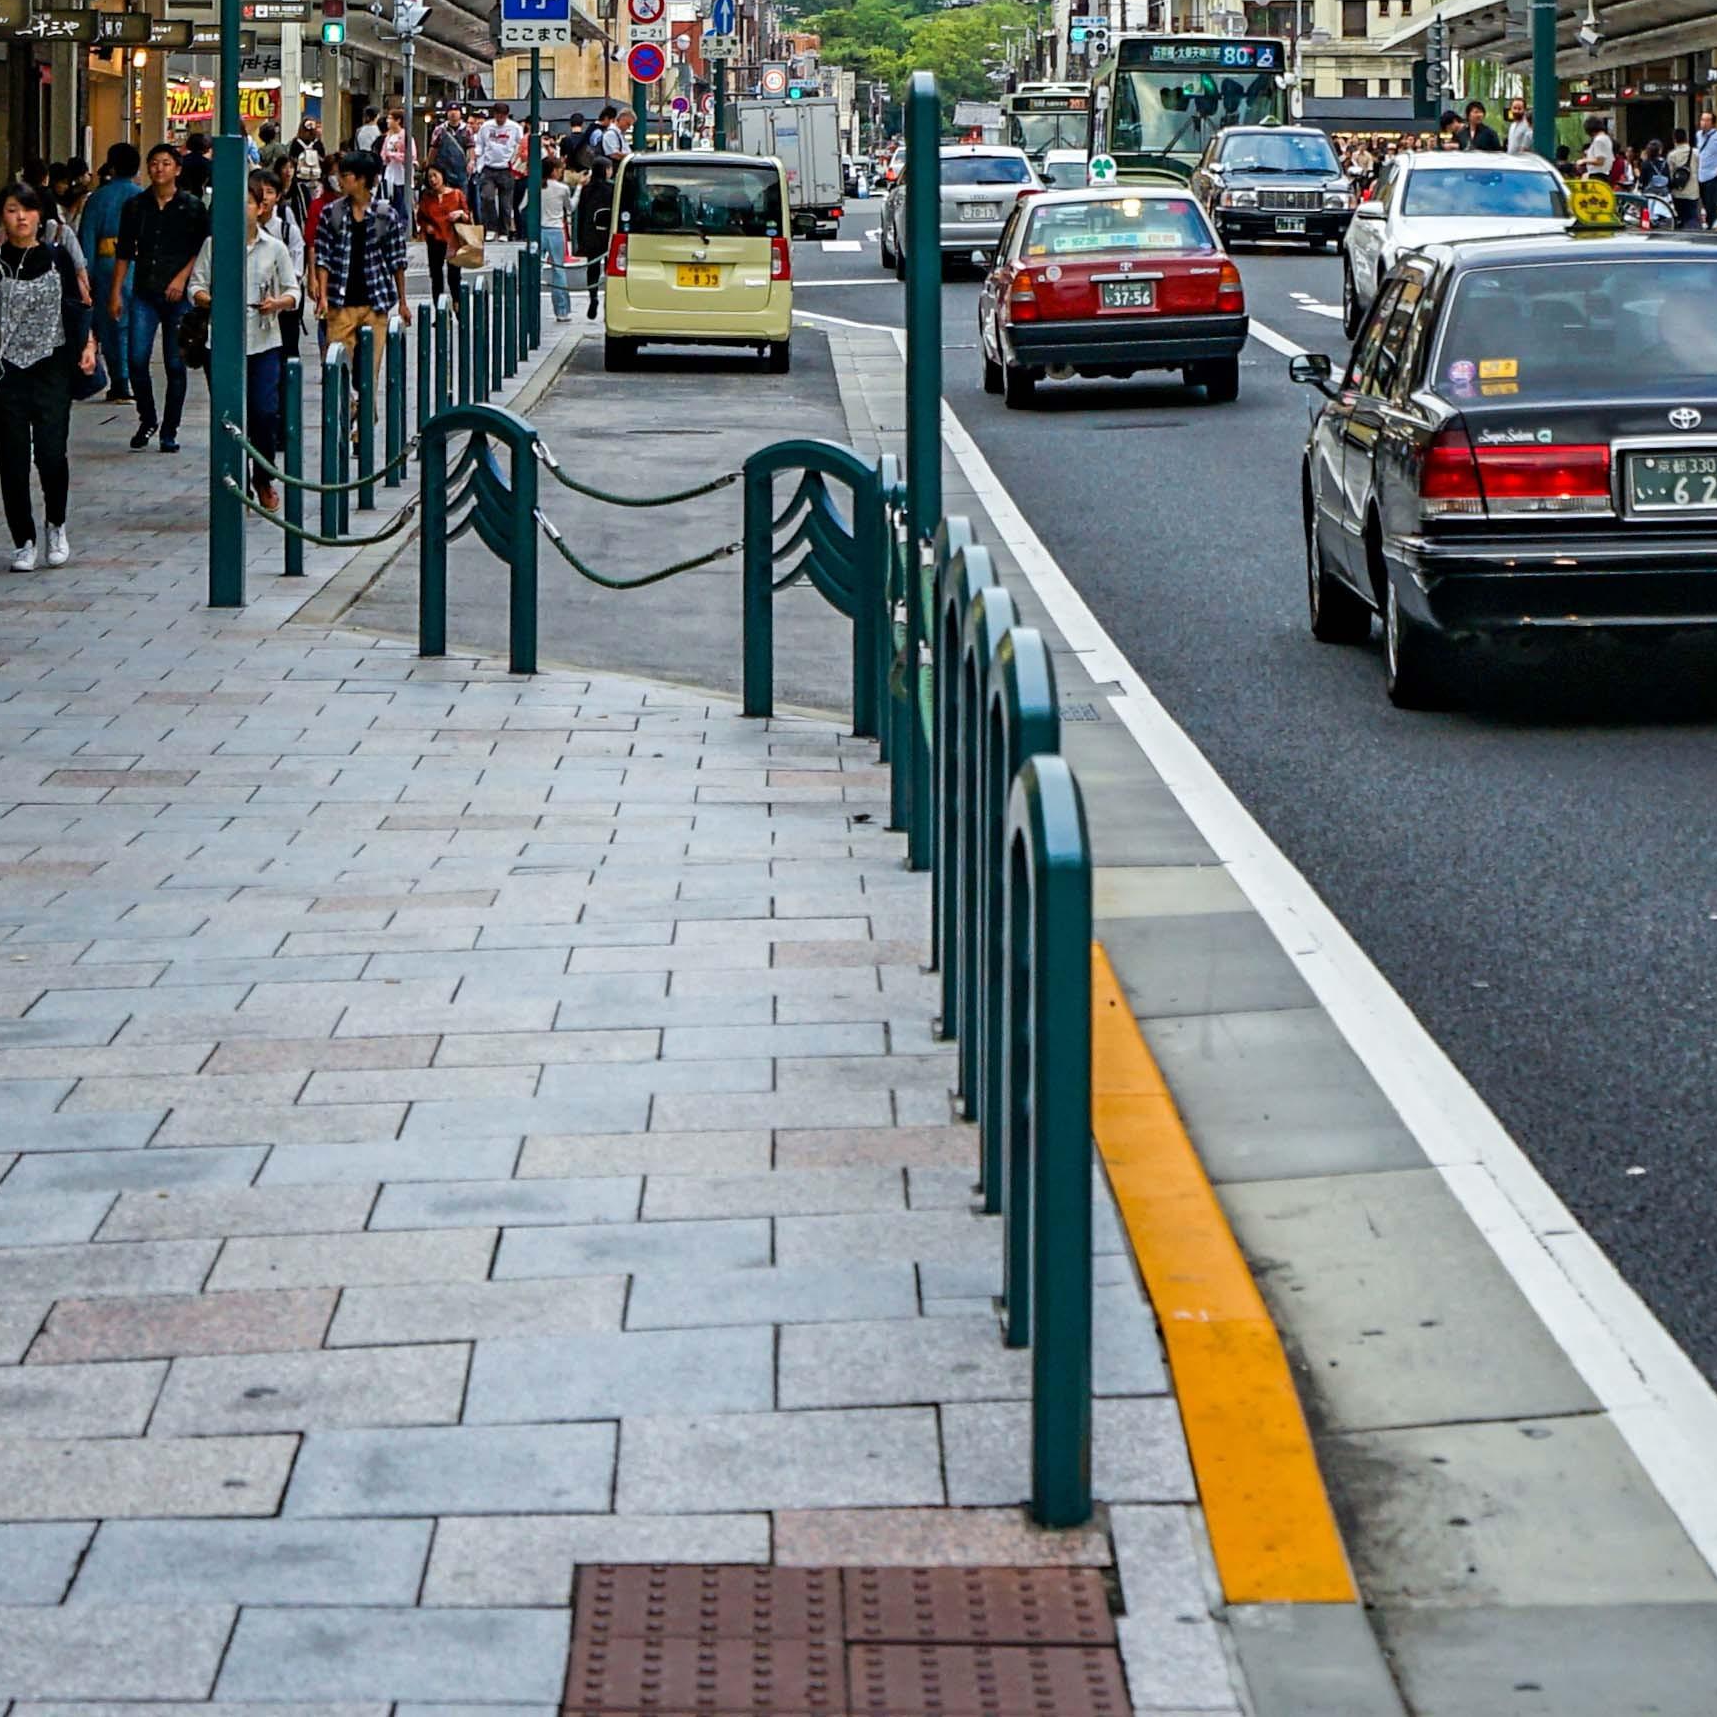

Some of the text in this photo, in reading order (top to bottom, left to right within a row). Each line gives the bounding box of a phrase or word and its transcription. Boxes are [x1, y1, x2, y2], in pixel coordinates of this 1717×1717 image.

[505, 27, 567, 42] ここまで
[1223, 47, 1248, 65] 80
[1114, 292, 1151, 306] 37-56
